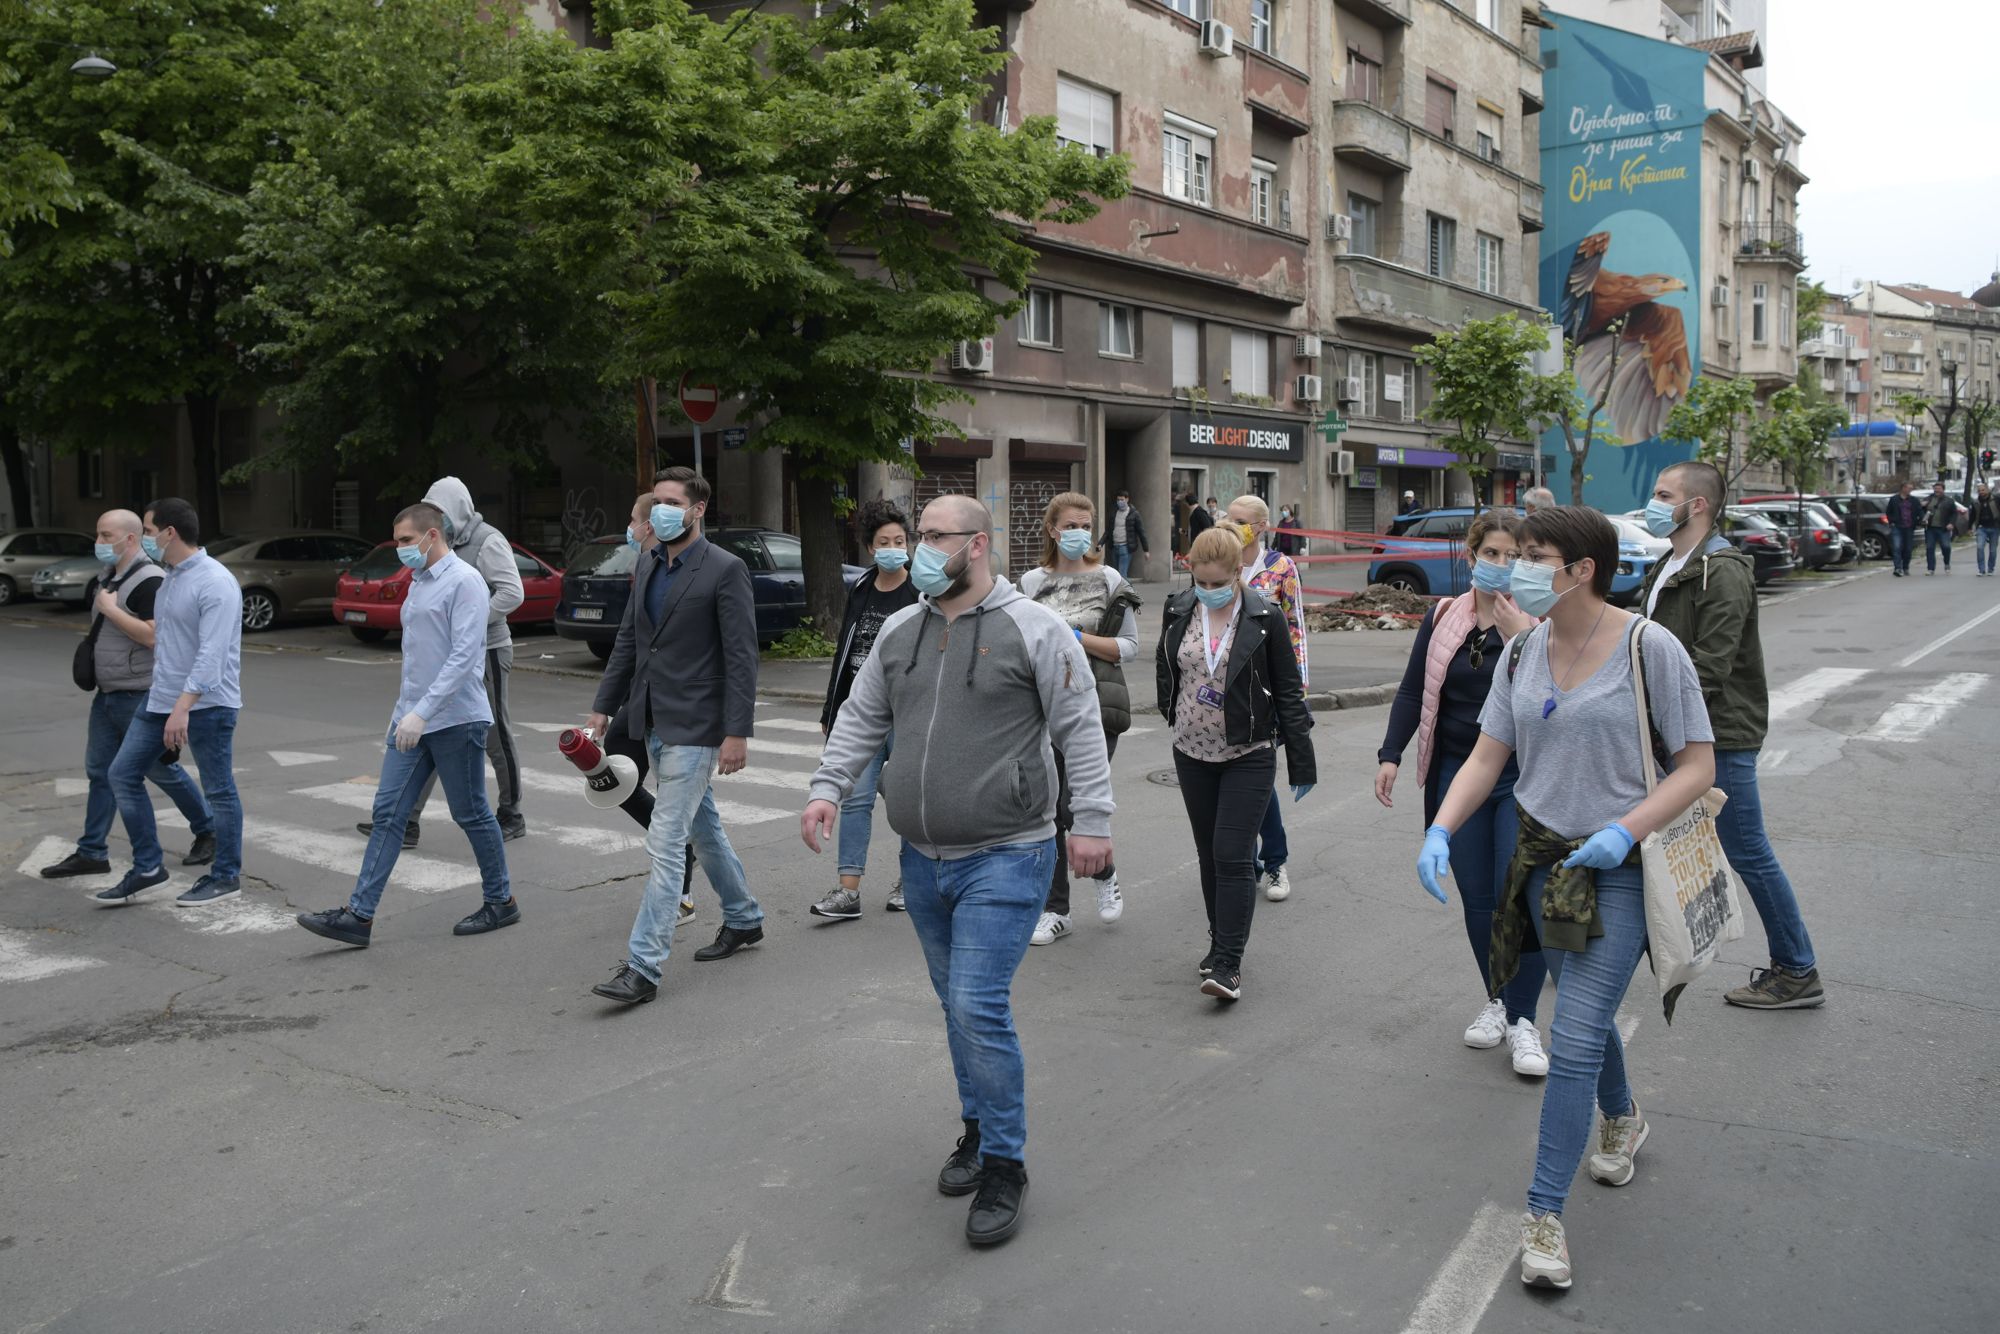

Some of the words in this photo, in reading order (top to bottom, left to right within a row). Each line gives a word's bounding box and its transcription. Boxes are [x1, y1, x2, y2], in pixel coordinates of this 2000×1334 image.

[1190, 424, 1290, 450] BERLIGHT.DESIGN
[1317, 423, 1347, 431] APOTEKA
[1378, 448, 1398, 462] APOTEKA
[1662, 819, 1694, 850] SUBOTICA
